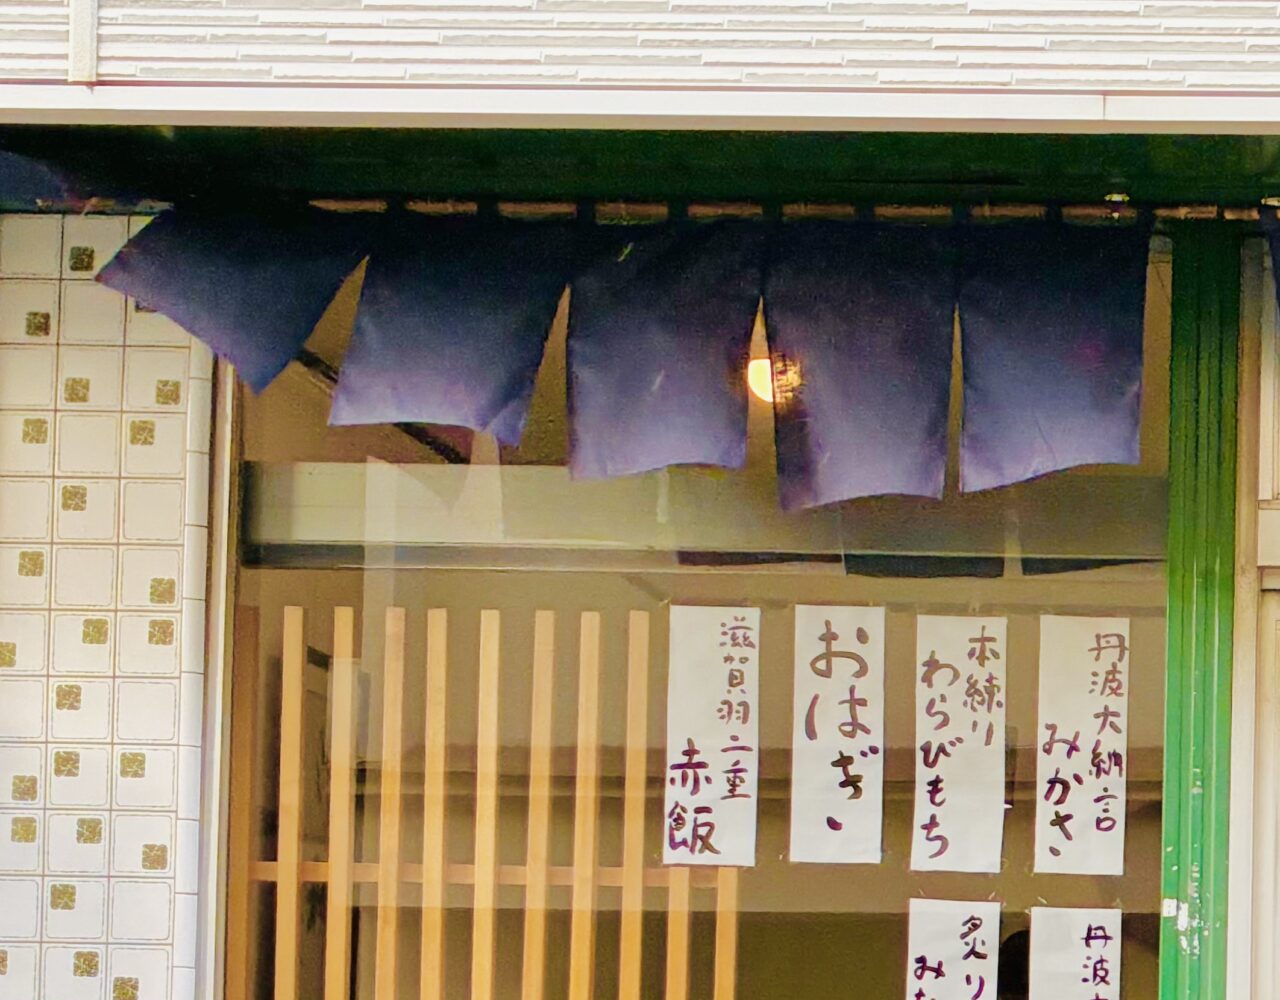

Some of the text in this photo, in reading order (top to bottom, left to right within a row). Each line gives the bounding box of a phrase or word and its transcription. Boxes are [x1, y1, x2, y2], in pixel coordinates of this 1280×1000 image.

[716, 616, 757, 801] 滋賀羽二重
[804, 619, 880, 831] おはぎ
[920, 649, 963, 859] わらびもち
[964, 624, 1003, 746] 本練り
[1088, 632, 1130, 832] 丹波大納言
[668, 737, 722, 856] 赤飯
[1042, 723, 1084, 857] みかさ
[959, 914, 989, 1000] 炙り
